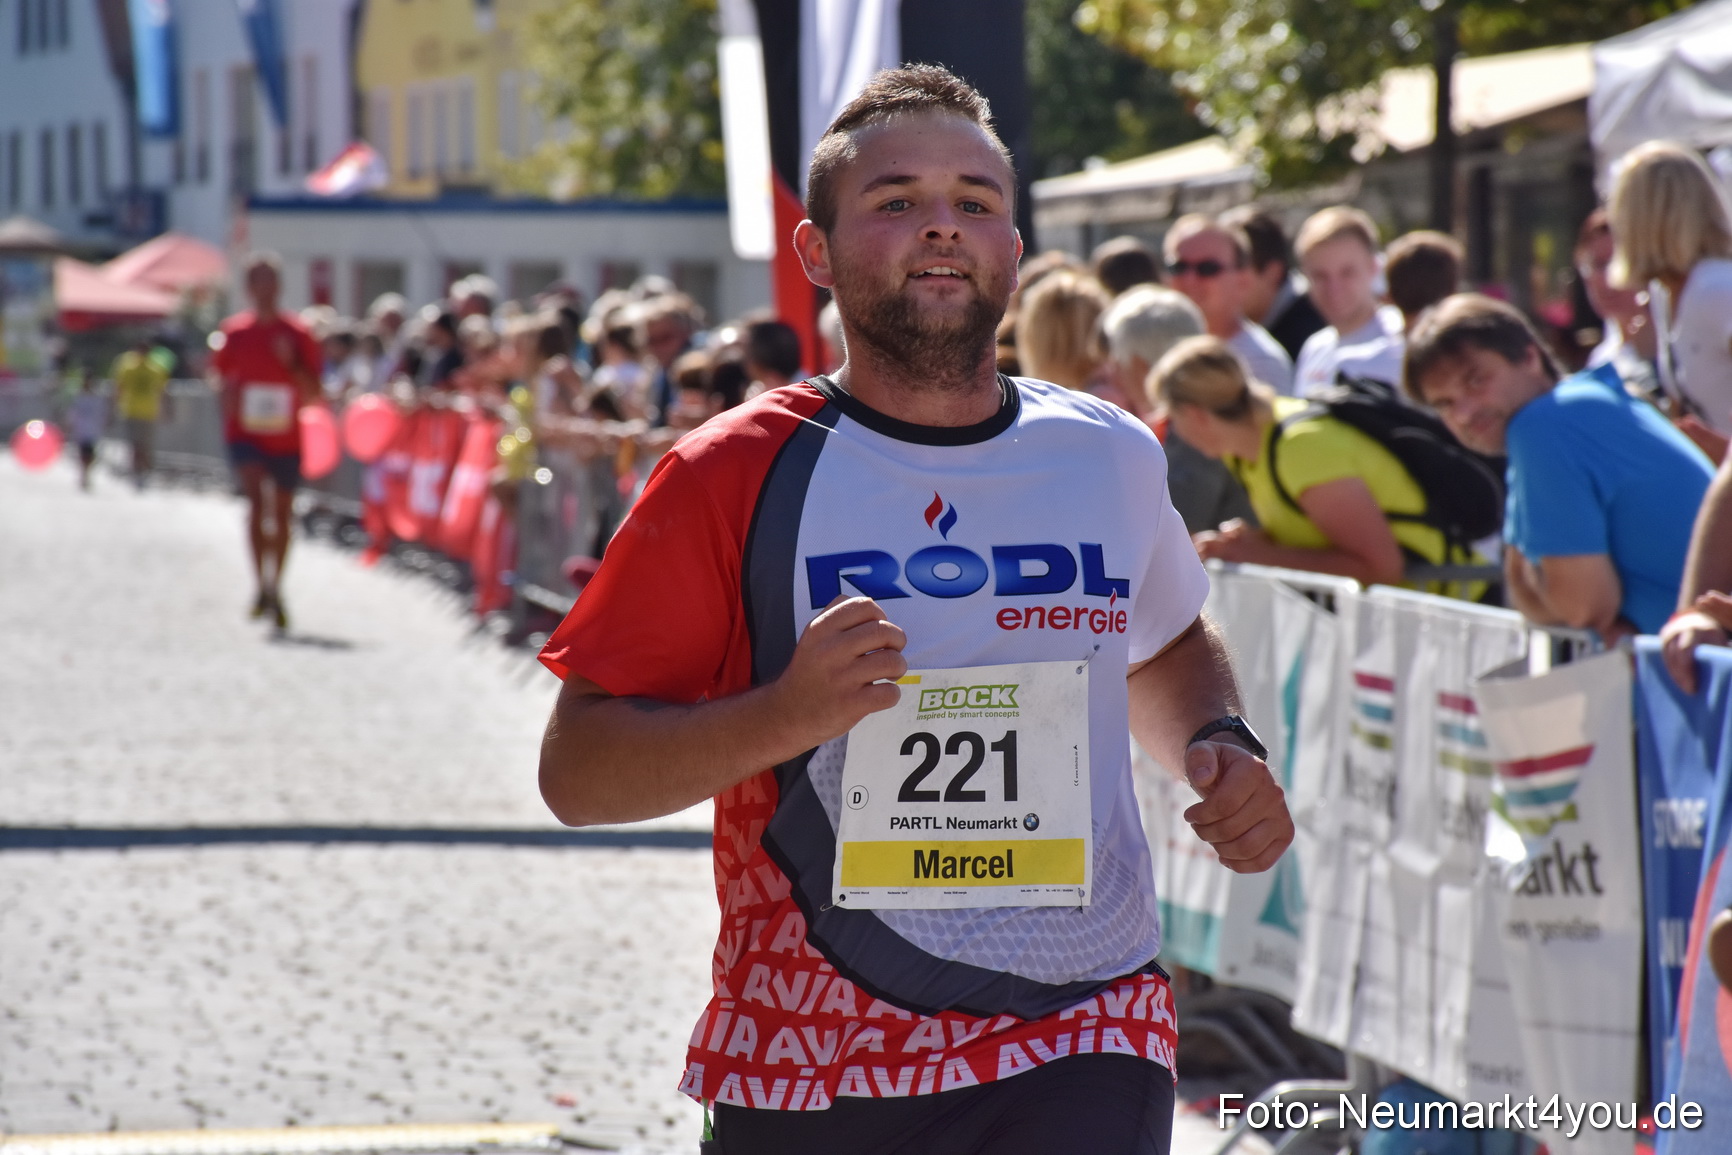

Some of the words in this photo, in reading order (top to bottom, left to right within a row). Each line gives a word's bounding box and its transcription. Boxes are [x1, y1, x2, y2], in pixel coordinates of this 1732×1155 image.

[996, 592, 1128, 635] energie
[918, 684, 1020, 712] BOCK
[916, 711, 946, 721] inspired
[947, 711, 958, 720] by
[960, 710, 983, 719] smart
[985, 710, 1020, 719] concepts
[897, 730, 1018, 803] 221
[889, 816, 943, 830] PARTL
[946, 816, 1018, 830] Neumarkt
[913, 848, 1014, 880] Marcel
